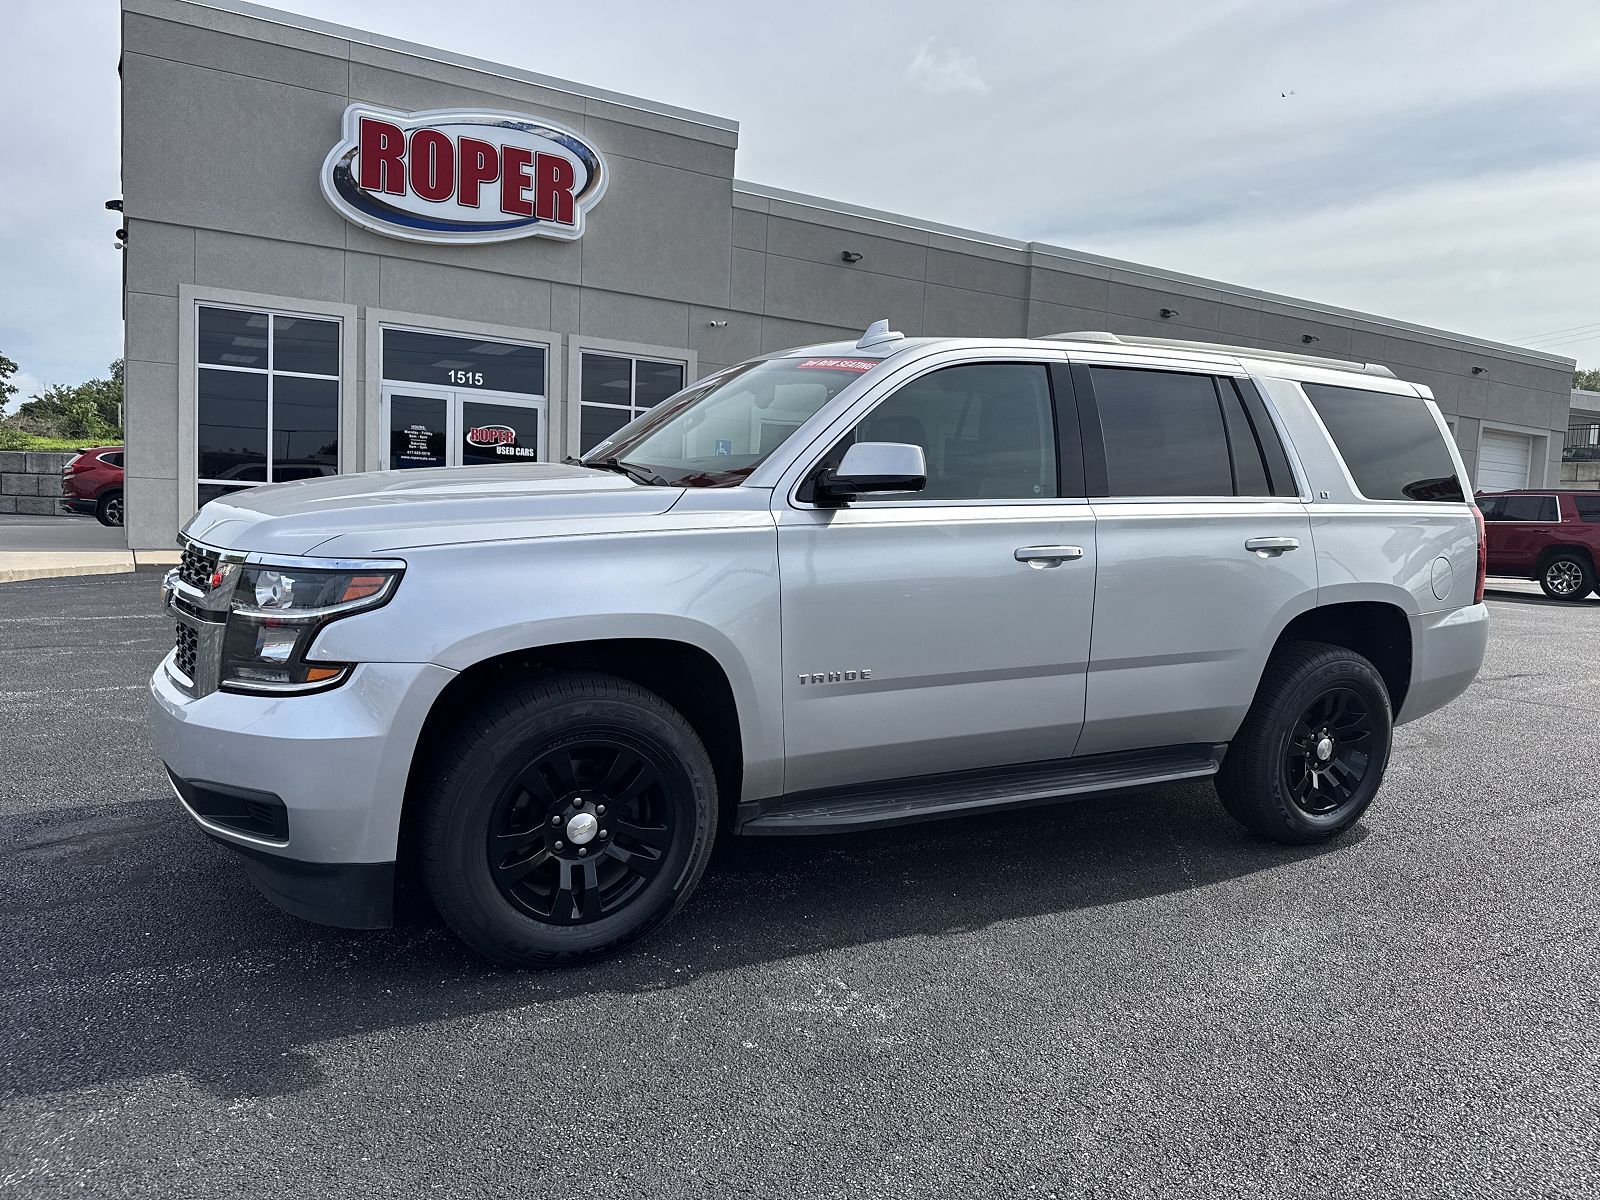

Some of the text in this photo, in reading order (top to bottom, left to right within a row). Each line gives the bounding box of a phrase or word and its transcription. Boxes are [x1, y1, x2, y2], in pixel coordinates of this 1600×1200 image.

[358, 116, 576, 226] ROPER
[837, 360, 877, 370] SEATING
[448, 369, 484, 386] 1515
[470, 427, 515, 445] ROPER
[496, 446, 535, 457] USED CARS
[1320, 490, 1331, 500] LT
[797, 668, 872, 685] TAHOE
